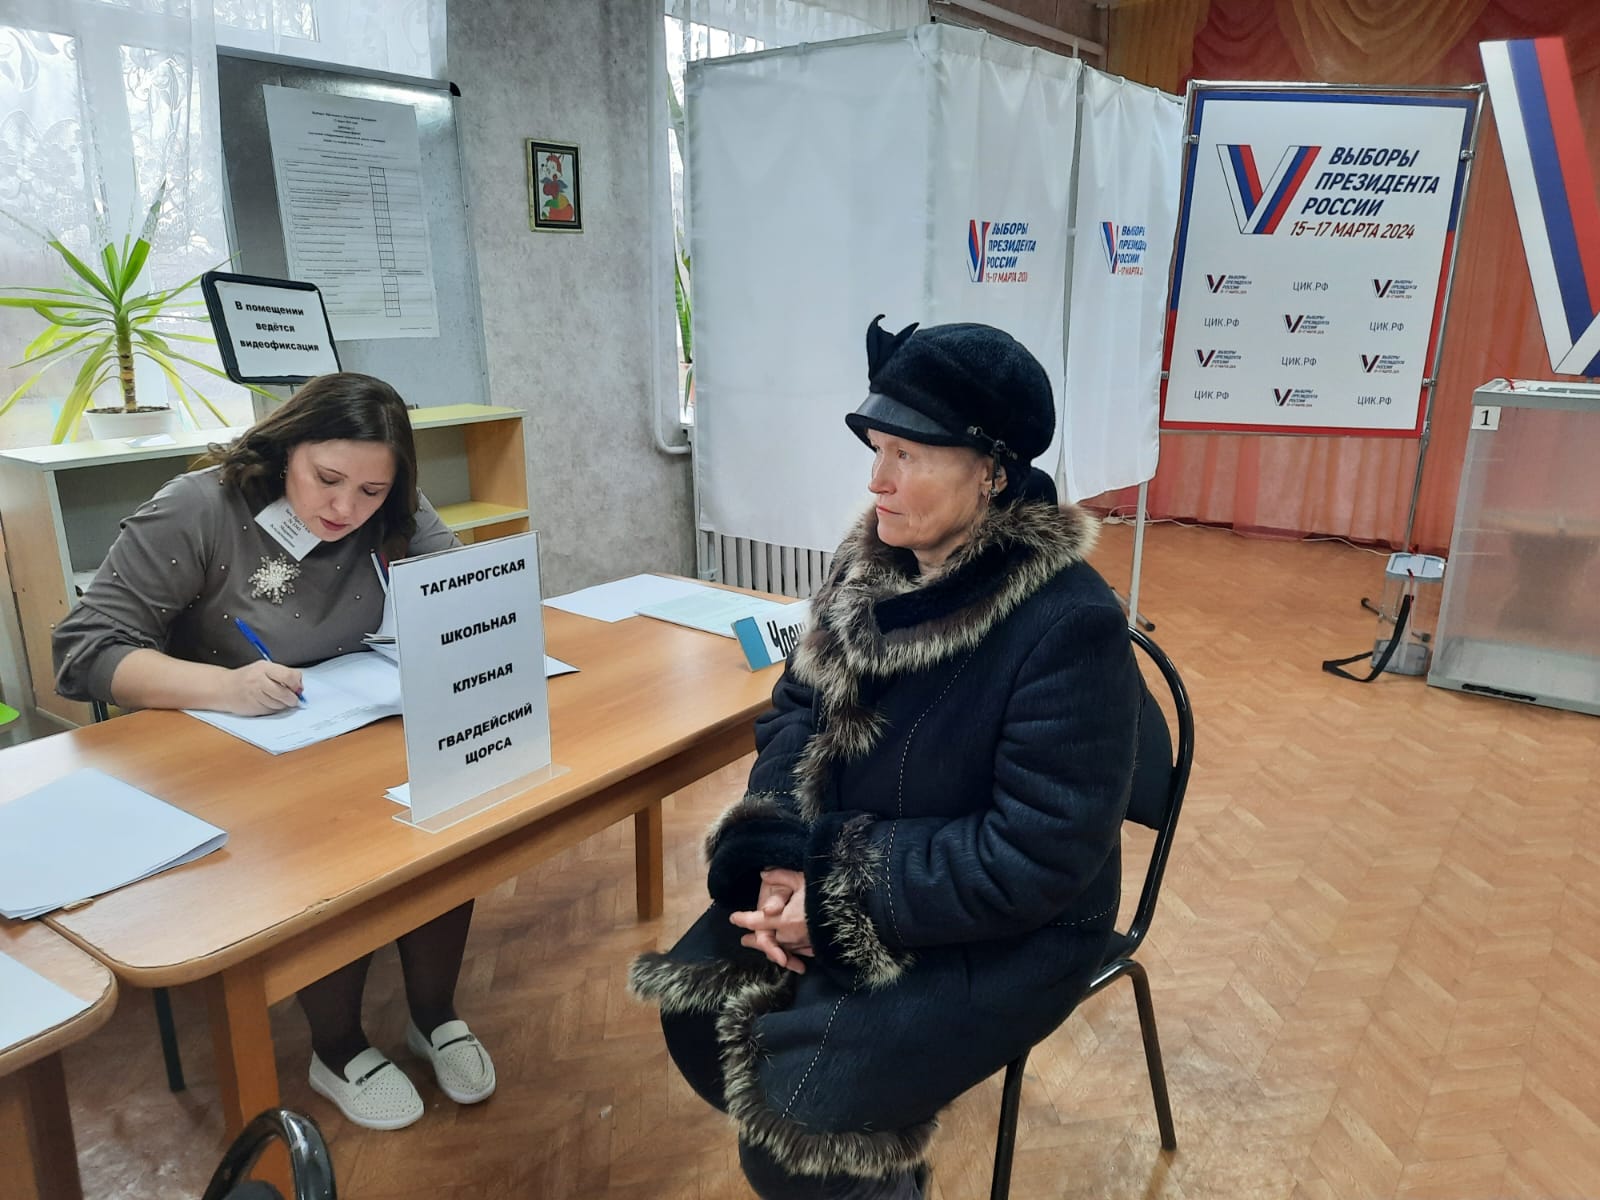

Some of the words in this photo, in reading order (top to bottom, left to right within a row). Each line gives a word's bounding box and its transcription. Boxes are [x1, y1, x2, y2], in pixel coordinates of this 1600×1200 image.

[1328, 146, 1420, 168] ВЫБОРЫ
[1314, 172, 1441, 194] ПРЕЗИДЕНТА
[1301, 197, 1384, 217] РОССИИ
[1332, 222, 1380, 239] МАРТА
[1380, 223, 1416, 239] 2024
[1292, 281, 1329, 292] ЦИК.РФ
[234, 301, 243, 311] В
[245, 304, 304, 316] помещении
[255, 322, 295, 333] ведётся
[1204, 317, 1240, 329] ЦИК.РФ
[1369, 321, 1404, 332] ЦИК.РФ
[240, 340, 320, 352] видеофиксация
[1281, 356, 1317, 367] ЦИК.РФ
[1194, 390, 1229, 401] ЦИК.РФ
[1357, 395, 1392, 406] ЦИК.РФ
[1480, 409, 1491, 426] 1
[420, 559, 526, 596] ТАГАНРОГСКАЯ
[440, 612, 517, 645] ШКОЛЬНАЯ
[452, 662, 514, 694] КЛУБНАЯ
[438, 702, 533, 751] ГВАРДЕЙСКИЙ
[465, 736, 513, 765] ЩОРСА
